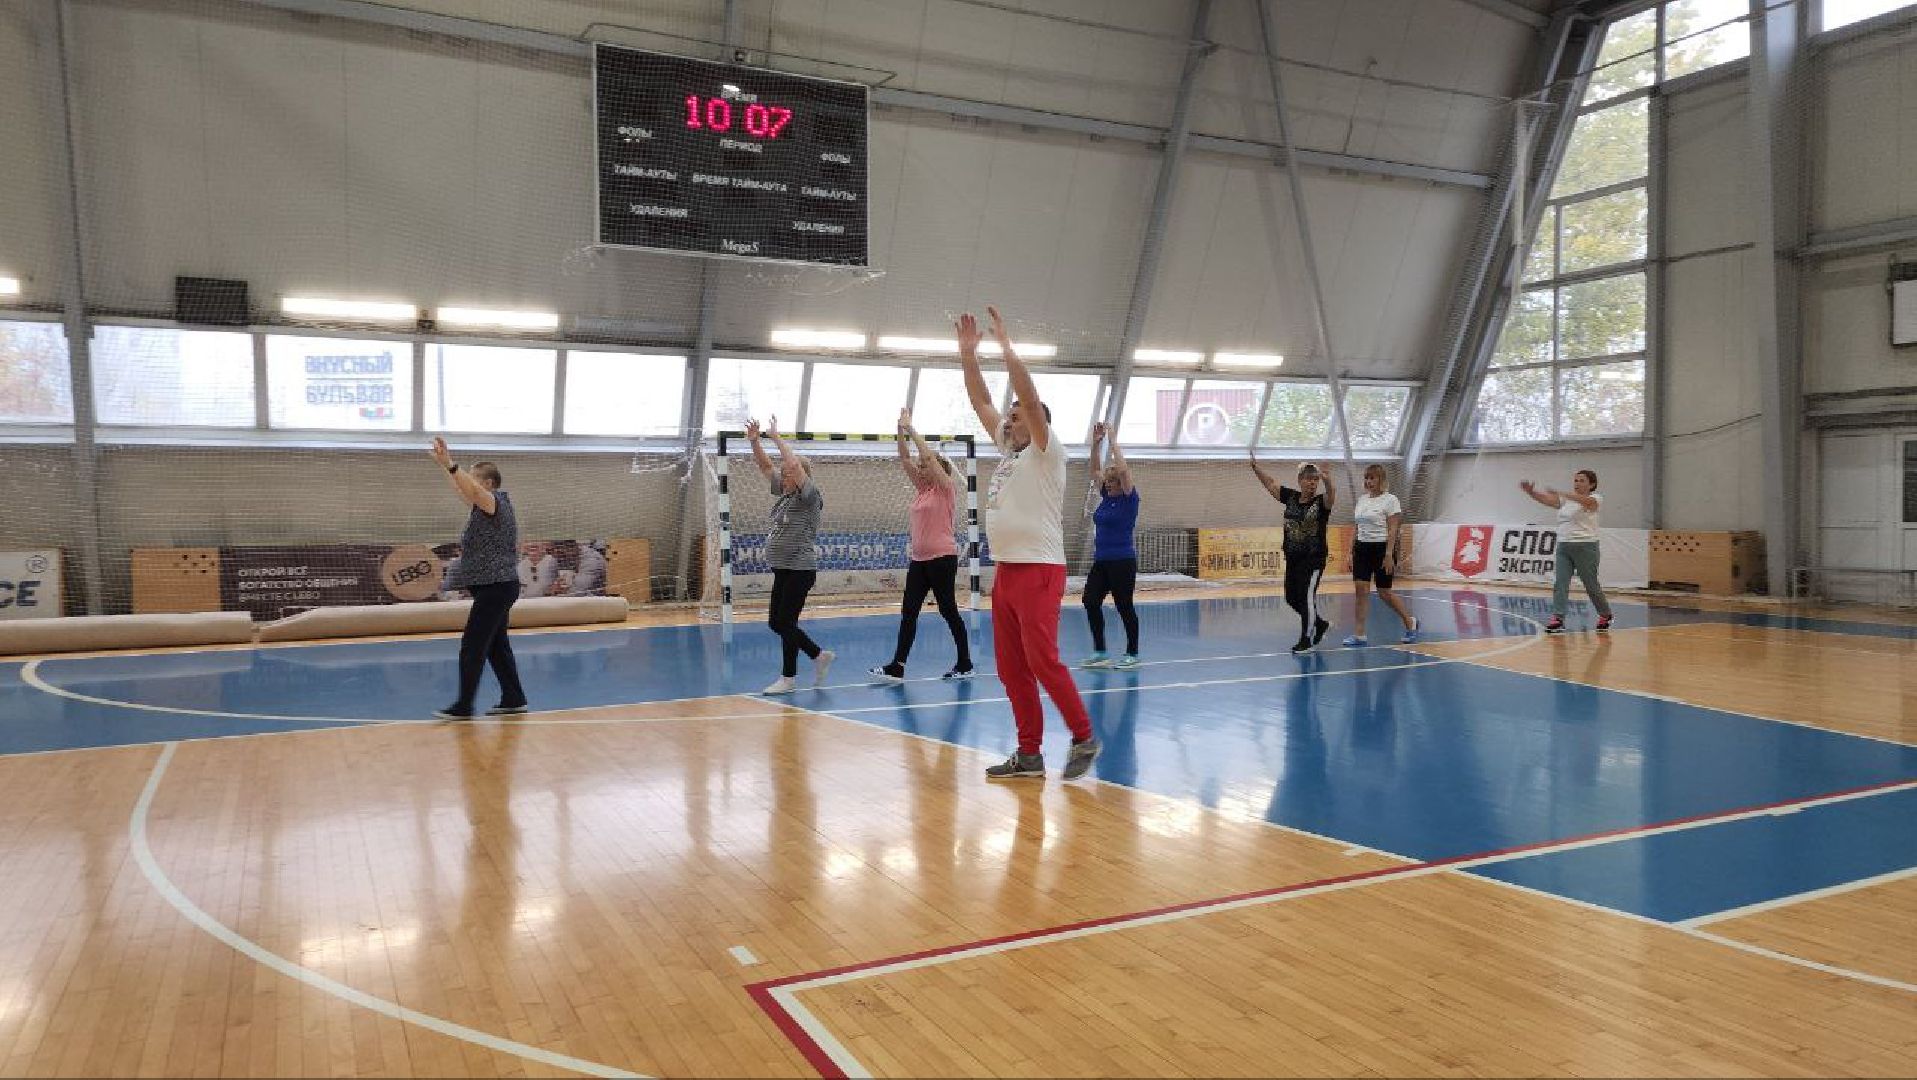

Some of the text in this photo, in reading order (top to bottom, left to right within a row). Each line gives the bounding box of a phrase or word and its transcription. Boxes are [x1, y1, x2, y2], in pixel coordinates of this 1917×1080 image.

[685, 95, 793, 138] 10 07
[618, 127, 652, 138] ФОЛЫ
[720, 139, 762, 152] ПЕРИОД
[821, 153, 850, 164] ФОЛЫ
[614, 164, 678, 180] ТАЙМ-АУТЫ
[693, 172, 787, 192] ВРЕМЯ ТАЙМ-АУТА
[801, 185, 857, 201] ТАЙМ-АУТЫ
[629, 203, 688, 218] УДАЛЕНИЯ
[792, 220, 845, 234] УДАЛЕНИЯ
[305, 350, 393, 374] ВКУСНЫЙ
[306, 385, 393, 404] БУЛЬВАР
[1502, 530, 1557, 556] СПО
[392, 560, 431, 586] LEBO
[1499, 557, 1554, 575] ЭКСПР
